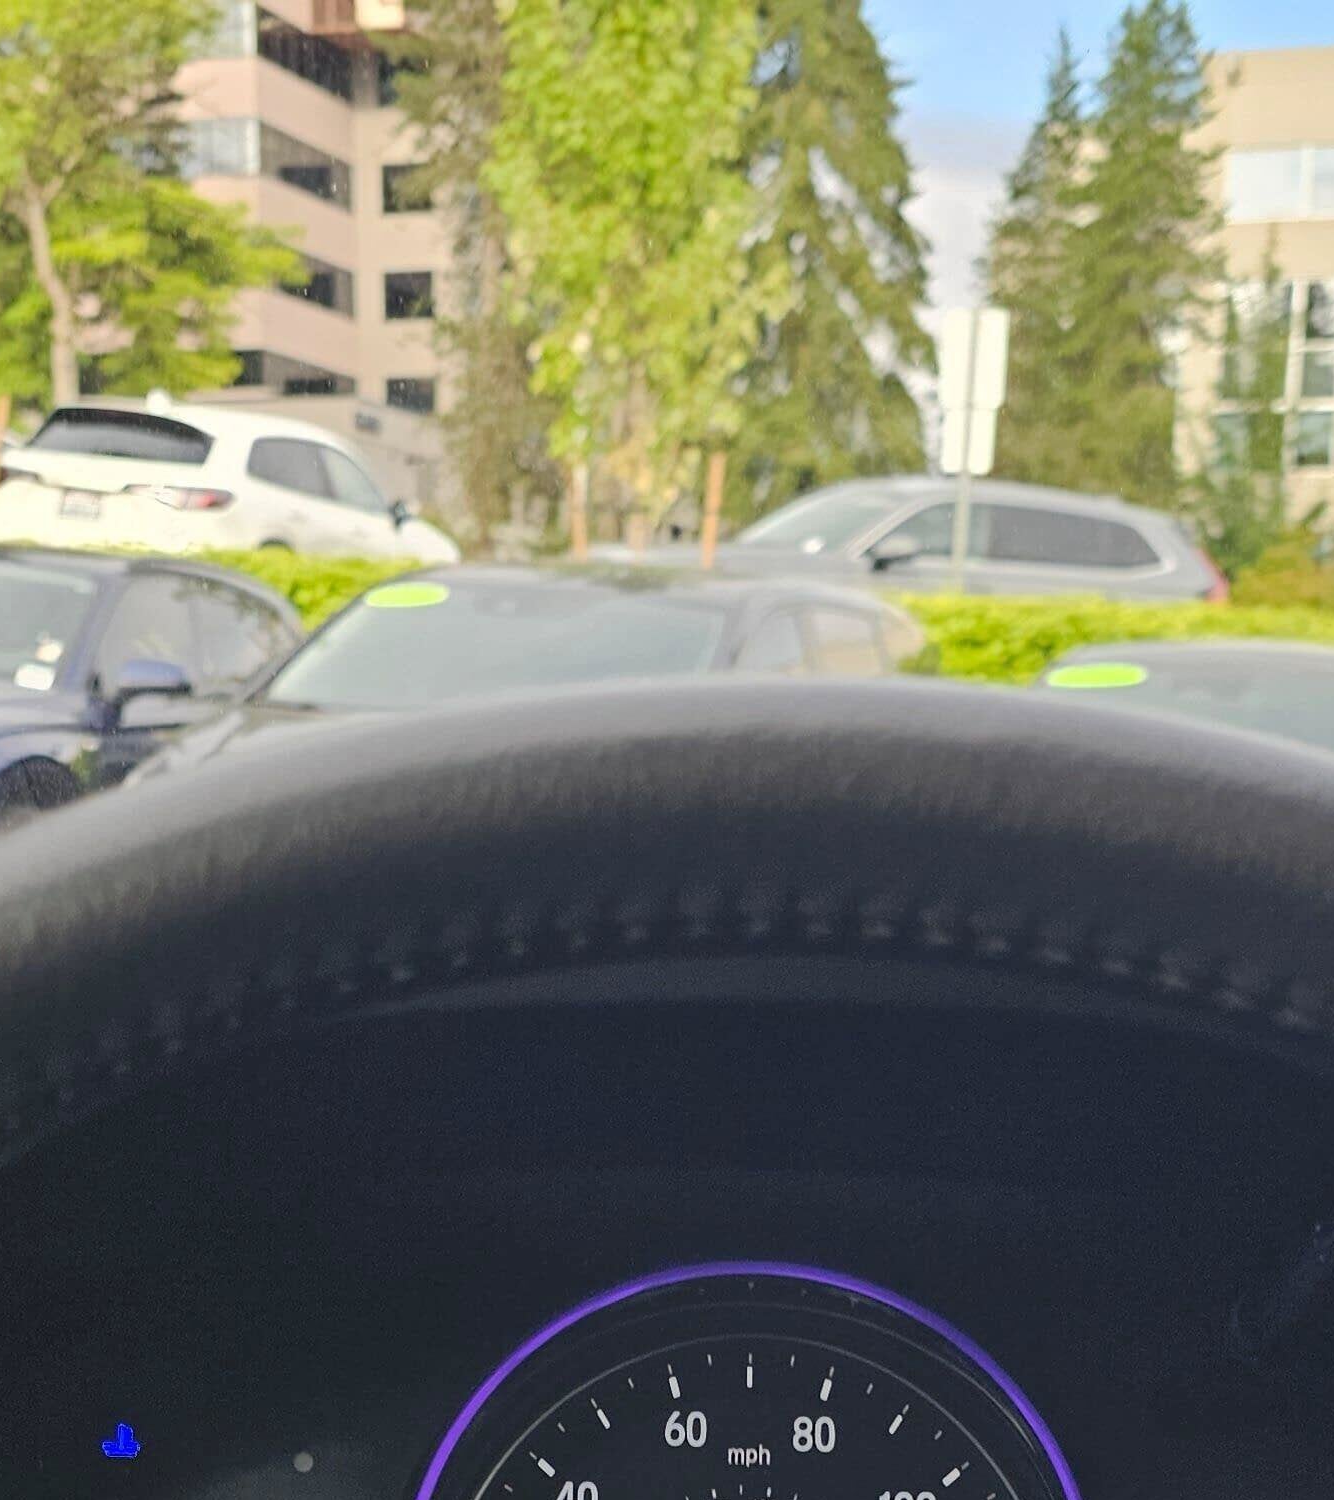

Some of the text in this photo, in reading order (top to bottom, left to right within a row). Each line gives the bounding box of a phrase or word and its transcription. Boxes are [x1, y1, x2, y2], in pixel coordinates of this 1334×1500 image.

[664, 1410, 708, 1448] 60
[792, 1415, 836, 1453] 80
[727, 1443, 771, 1468] mph
